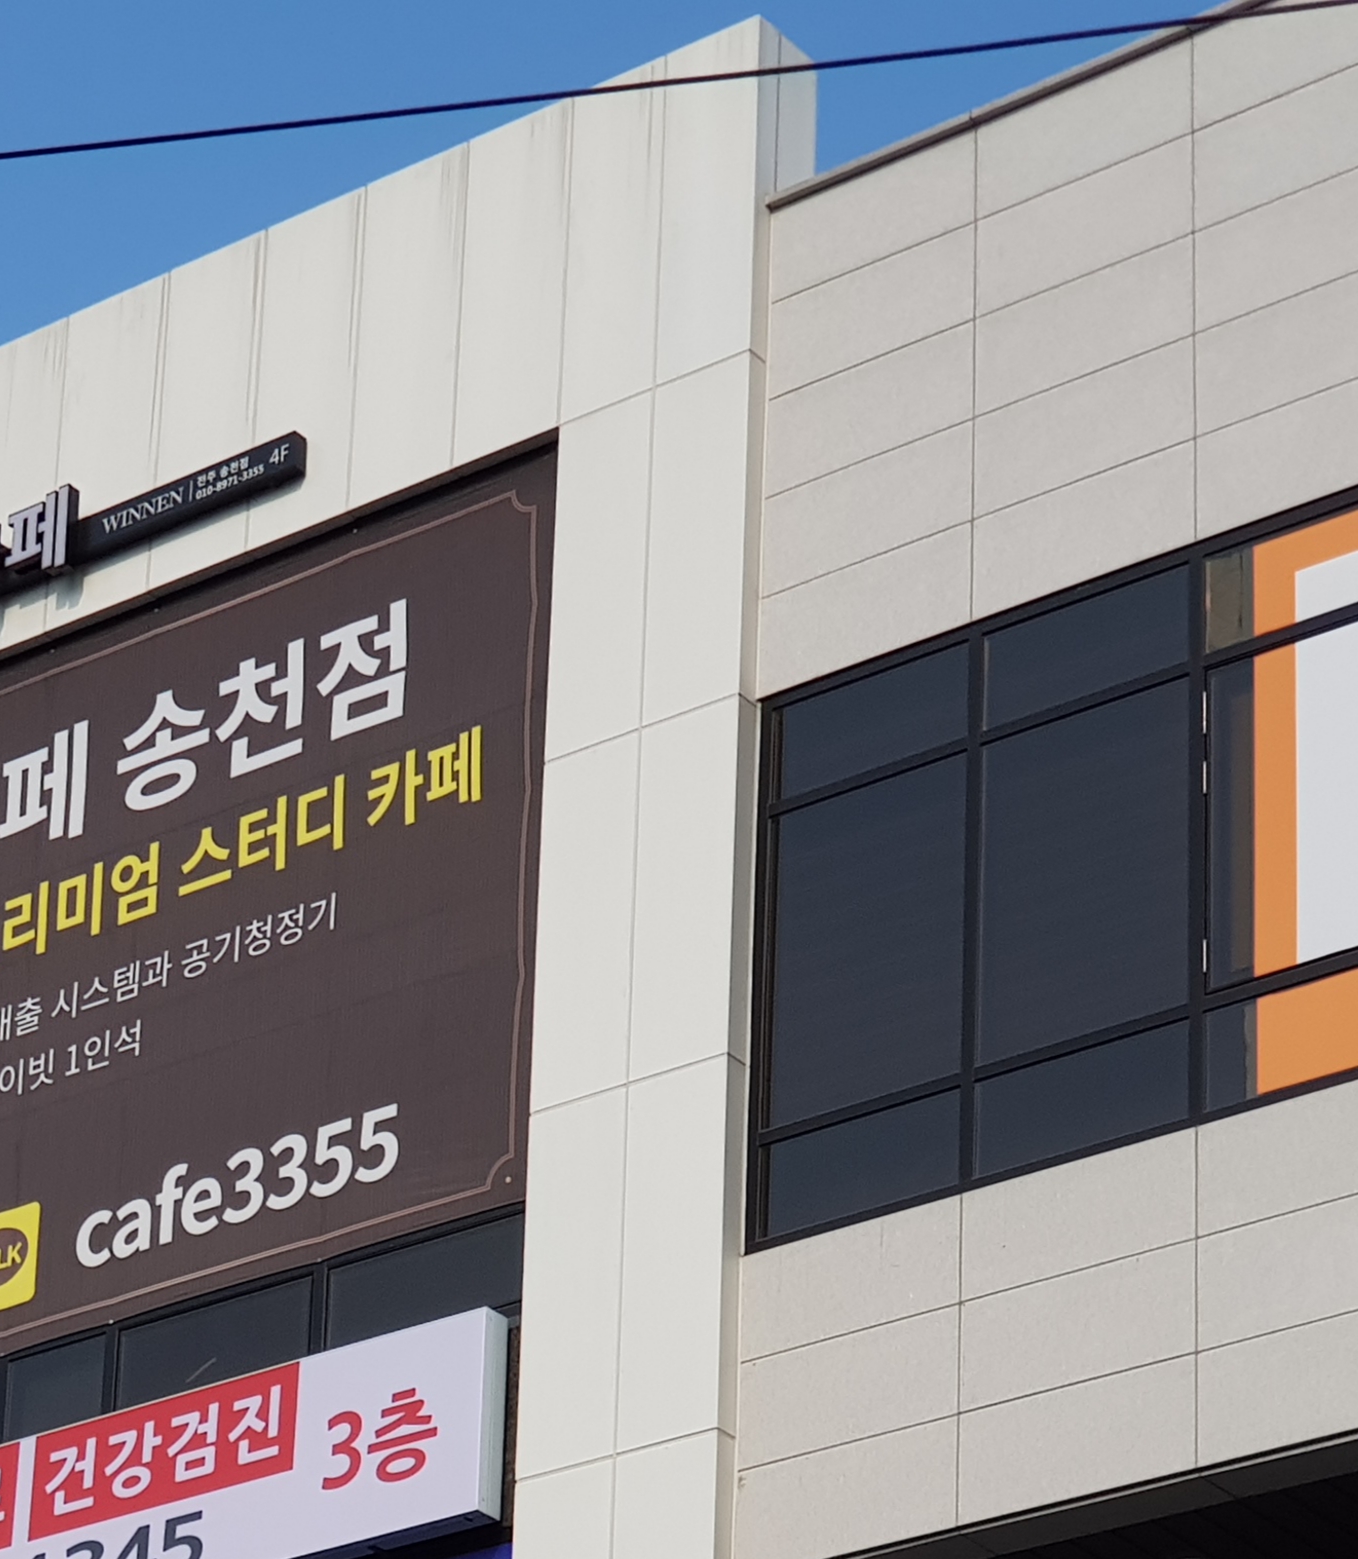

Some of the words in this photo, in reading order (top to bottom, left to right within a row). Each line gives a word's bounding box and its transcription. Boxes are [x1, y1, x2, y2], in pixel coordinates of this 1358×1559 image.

[102, 487, 184, 533] WINNEN
[196, 464, 264, 499] 010-8971-3355
[269, 443, 290, 465] 4F
[117, 599, 409, 812] 송천점
[178, 775, 345, 897] 스터디
[367, 725, 483, 828] 카페
[51, 950, 172, 1018] 시스템과
[181, 892, 337, 979] 공기청정기
[65, 1019, 142, 1077] 1인석
[75, 1103, 399, 1268] cafe3355
[45, 1384, 282, 1514] 건강검진
[322, 1388, 438, 1490] 3층
